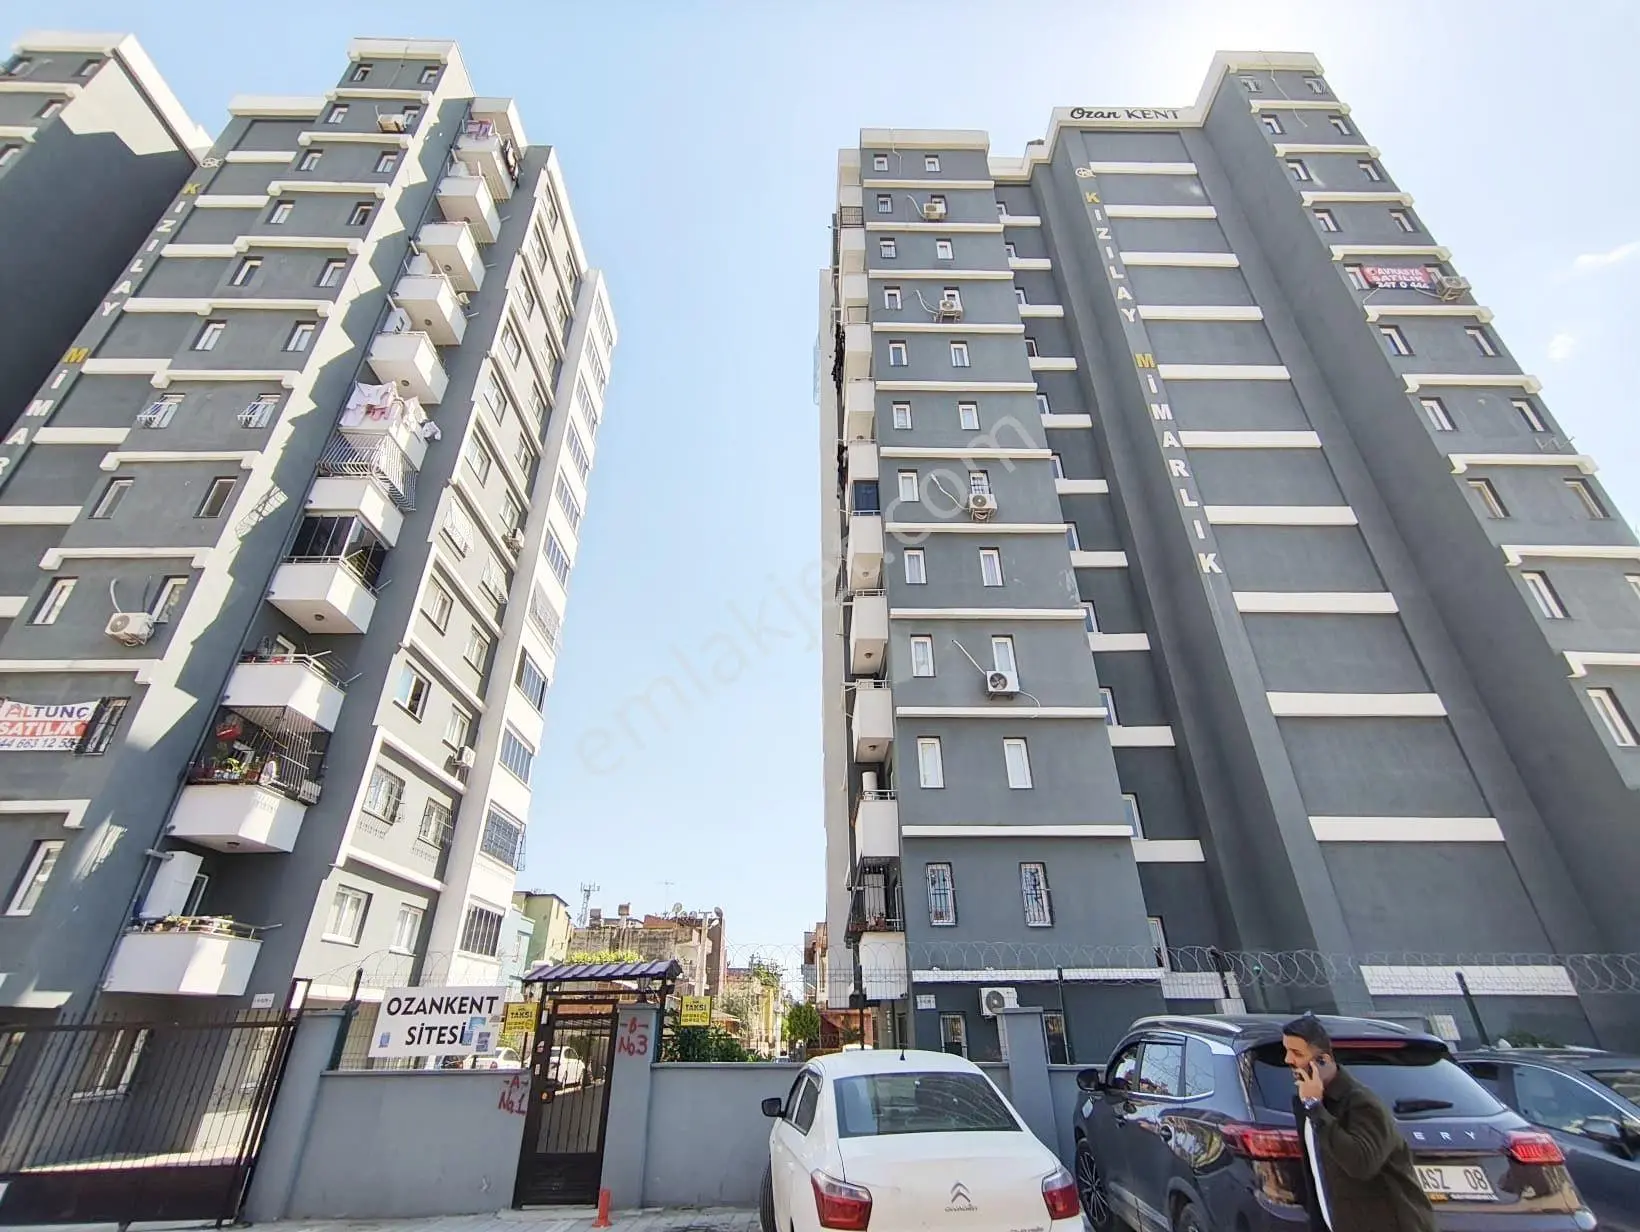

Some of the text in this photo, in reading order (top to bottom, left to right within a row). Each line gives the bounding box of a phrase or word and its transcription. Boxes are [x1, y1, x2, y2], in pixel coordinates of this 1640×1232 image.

[1070, 107, 1181, 120] Ozan KENT
[1085, 191, 1136, 323] KIZILAY
[386, 995, 500, 1016] OZANKENT
[405, 1021, 468, 1046] SİTESİ
[1463, 1168, 1489, 1191] 08
